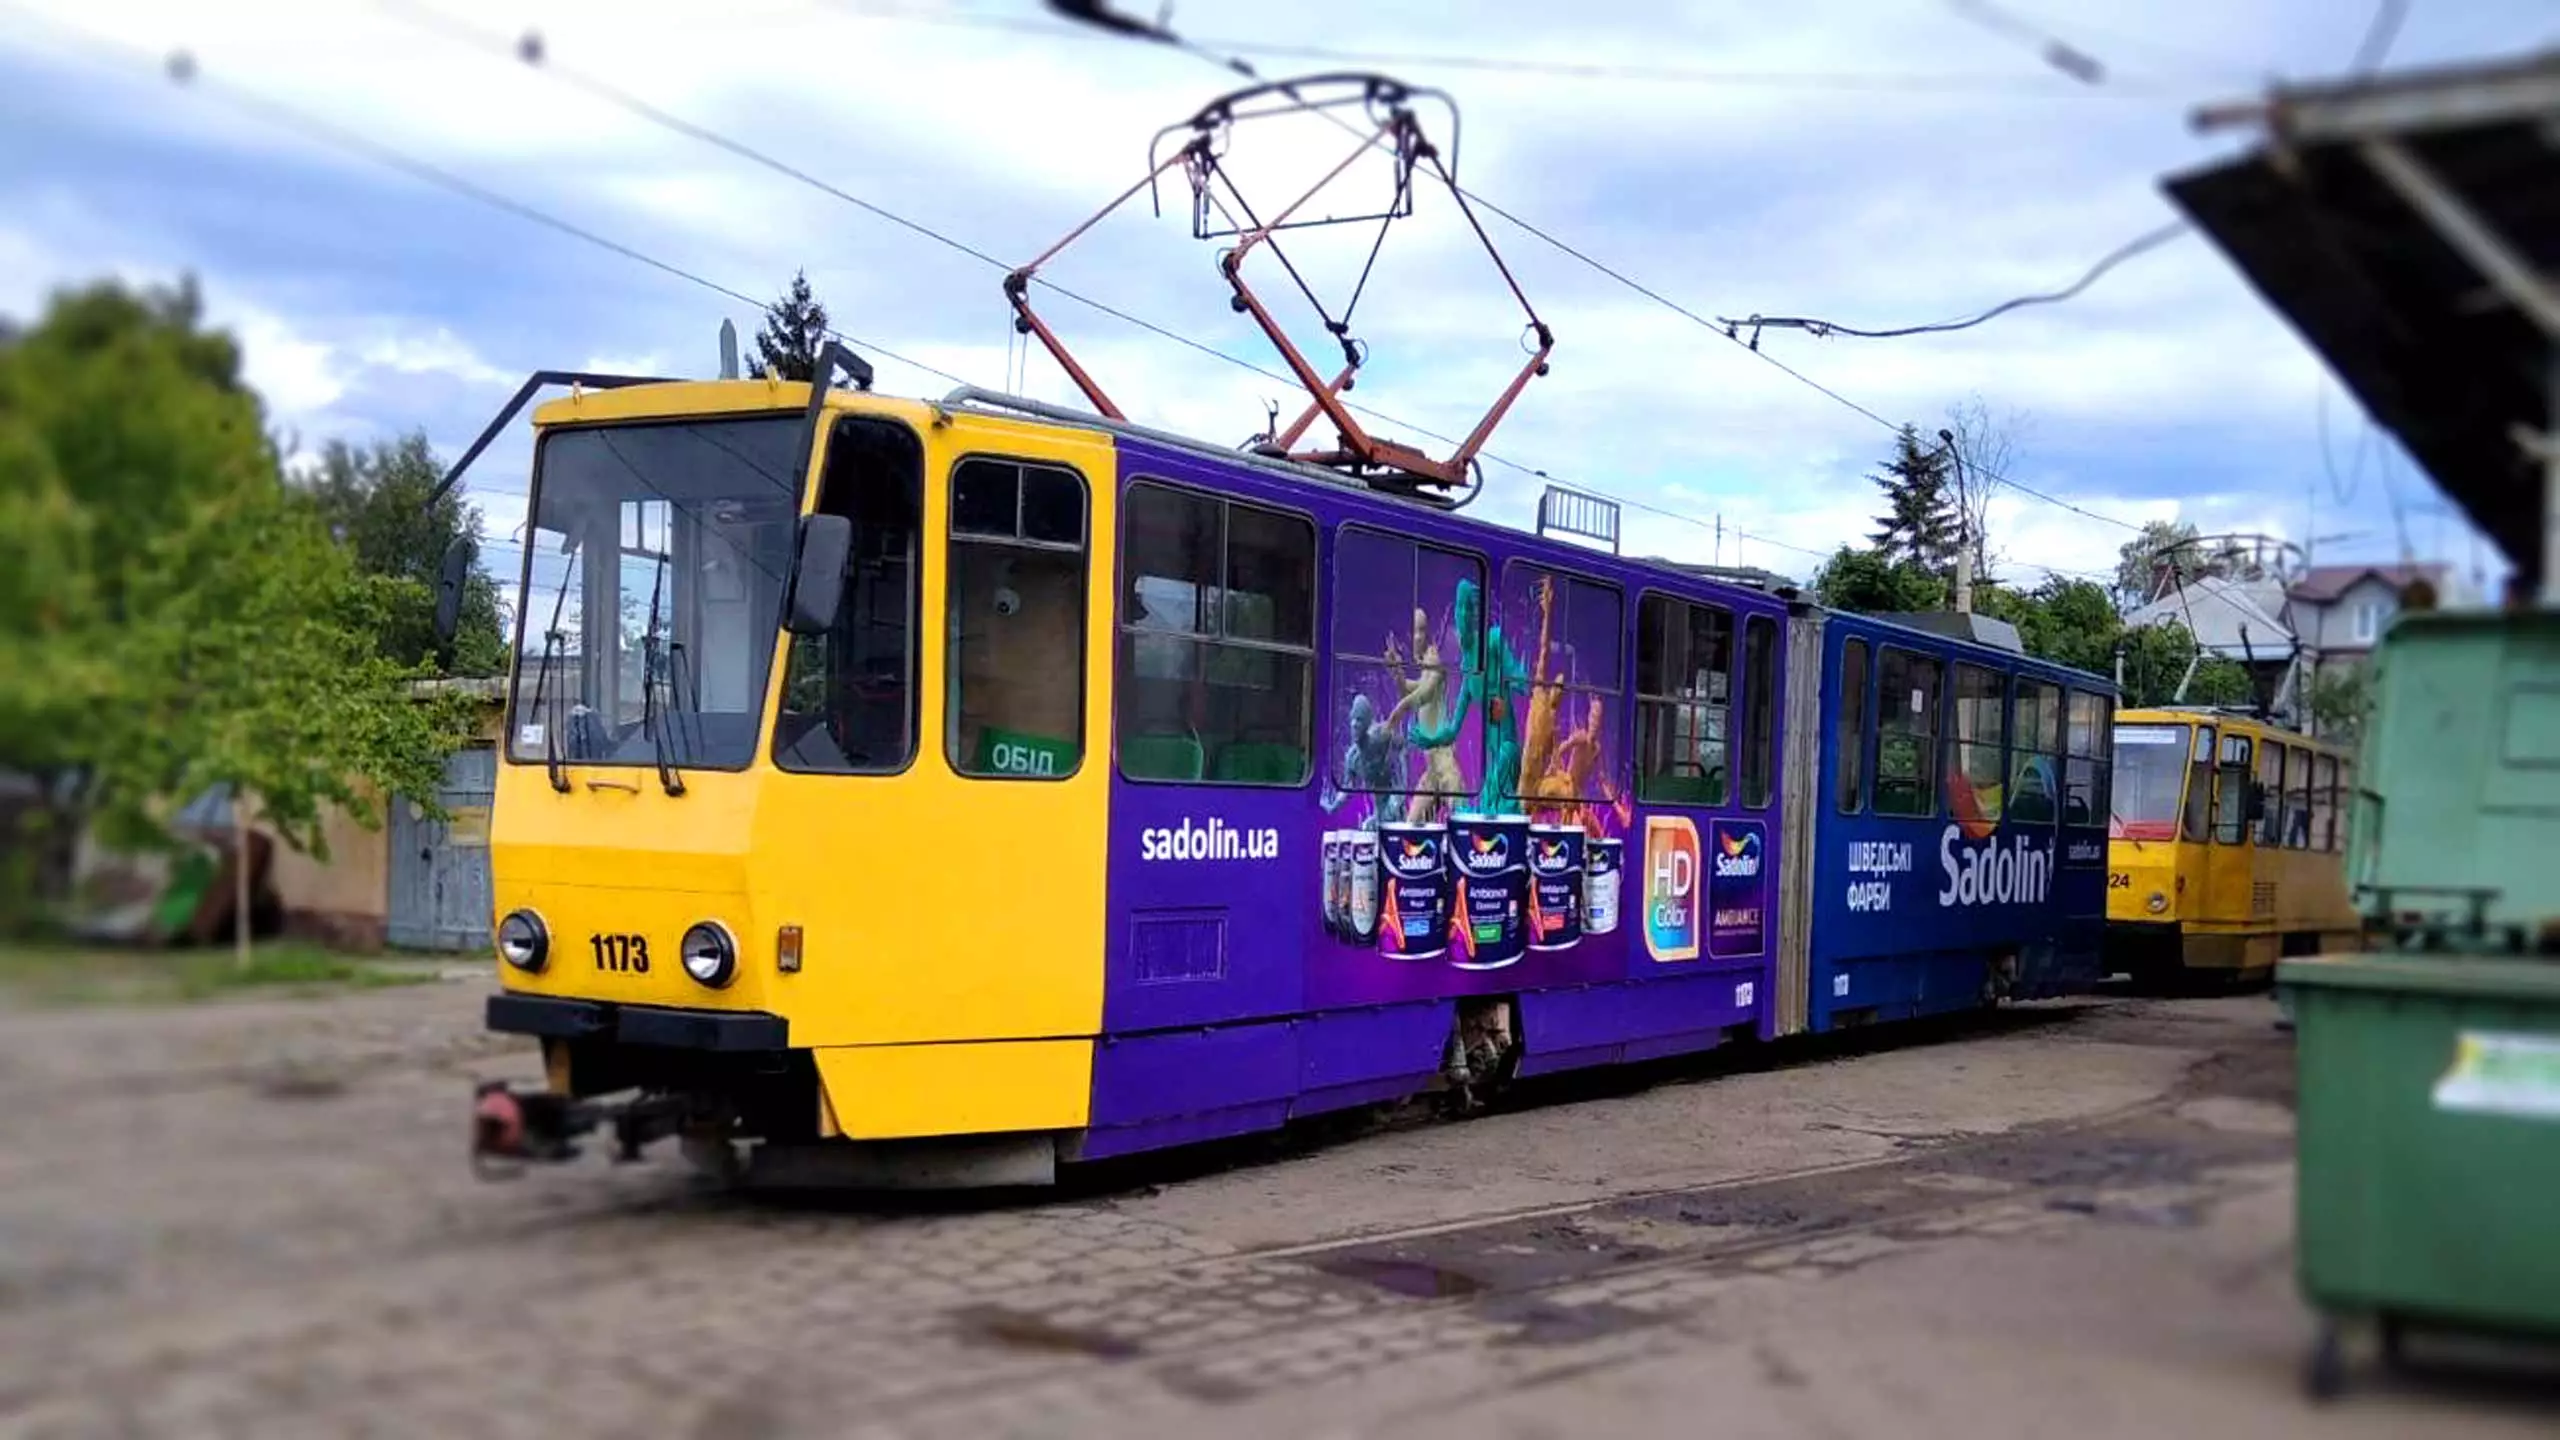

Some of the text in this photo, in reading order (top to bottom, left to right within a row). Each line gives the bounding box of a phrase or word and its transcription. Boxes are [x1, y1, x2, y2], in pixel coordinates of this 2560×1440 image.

[992, 743, 1053, 776] ОБІД
[1141, 816, 1279, 860] sadolin.ua
[1653, 850, 1692, 897] HD
[1848, 841, 1912, 878] ШВЕДСЬКІ
[1939, 823, 2045, 906] Sadolin
[1847, 881, 1891, 912] ФАРБИ
[2106, 872, 2130, 889] 24
[1655, 904, 1688, 927] Color
[589, 933, 649, 973] 1173
